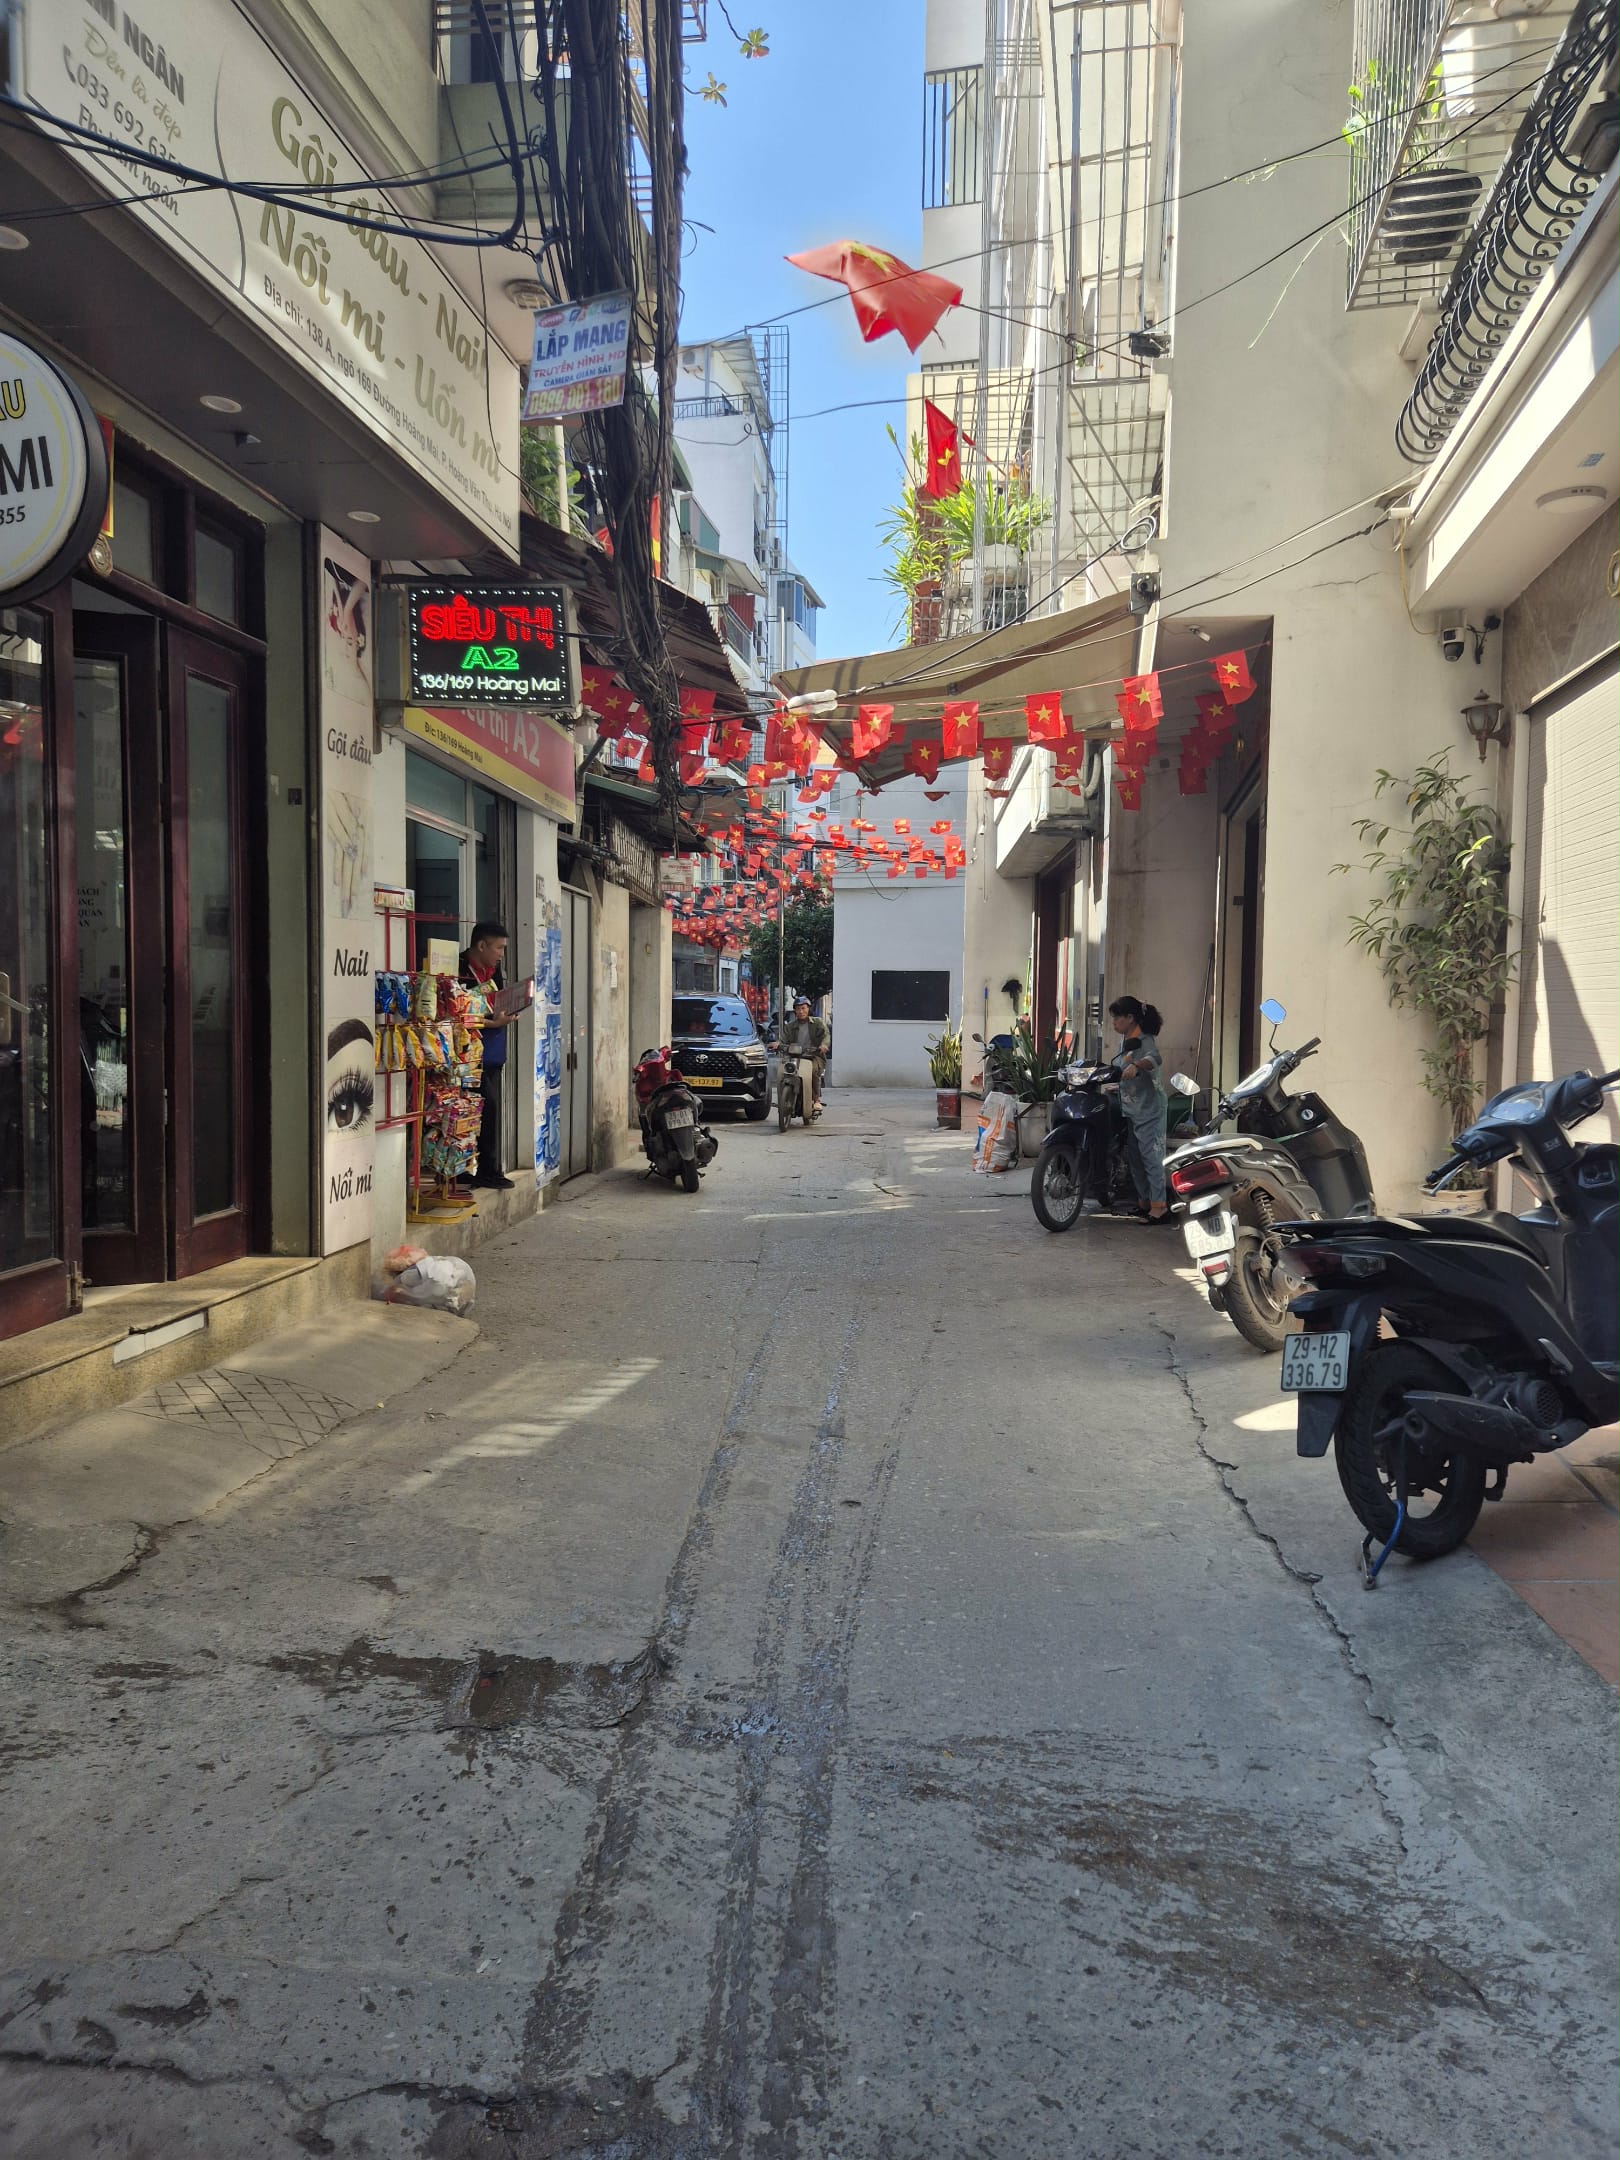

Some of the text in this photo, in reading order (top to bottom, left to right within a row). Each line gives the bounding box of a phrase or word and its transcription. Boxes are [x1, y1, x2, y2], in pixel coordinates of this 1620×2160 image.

[123, 11, 184, 106] NGÂN
[77, 63, 109, 109] 033
[113, 101, 143, 146] 692
[272, 97, 337, 209] Gội
[347, 197, 409, 296] đầu
[435, 292, 488, 388] Nail
[260, 198, 332, 305] Nối
[340, 289, 385, 362] mi
[415, 354, 467, 448] Uốn
[472, 431, 501, 483] mi
[536, 320, 627, 361] LẮP MẠNG
[264, 274, 282, 308] Địa
[307, 317, 323, 348] 138
[338, 352, 355, 378] ngõ
[357, 368, 371, 394] 169
[402, 411, 426, 451] Hoàng
[421, 593, 555, 650] SIÊU THỊ
[461, 646, 520, 670] A2
[419, 674, 561, 695] 136/169 Hoàng Mai
[327, 728, 372, 766] Gội đầu
[512, 710, 540, 769] A2
[334, 948, 368, 977] Nail
[330, 1165, 373, 1205] Nối mi
[1292, 1335, 1338, 1360] 29-H2
[1285, 1362, 1342, 1387] 336.79
